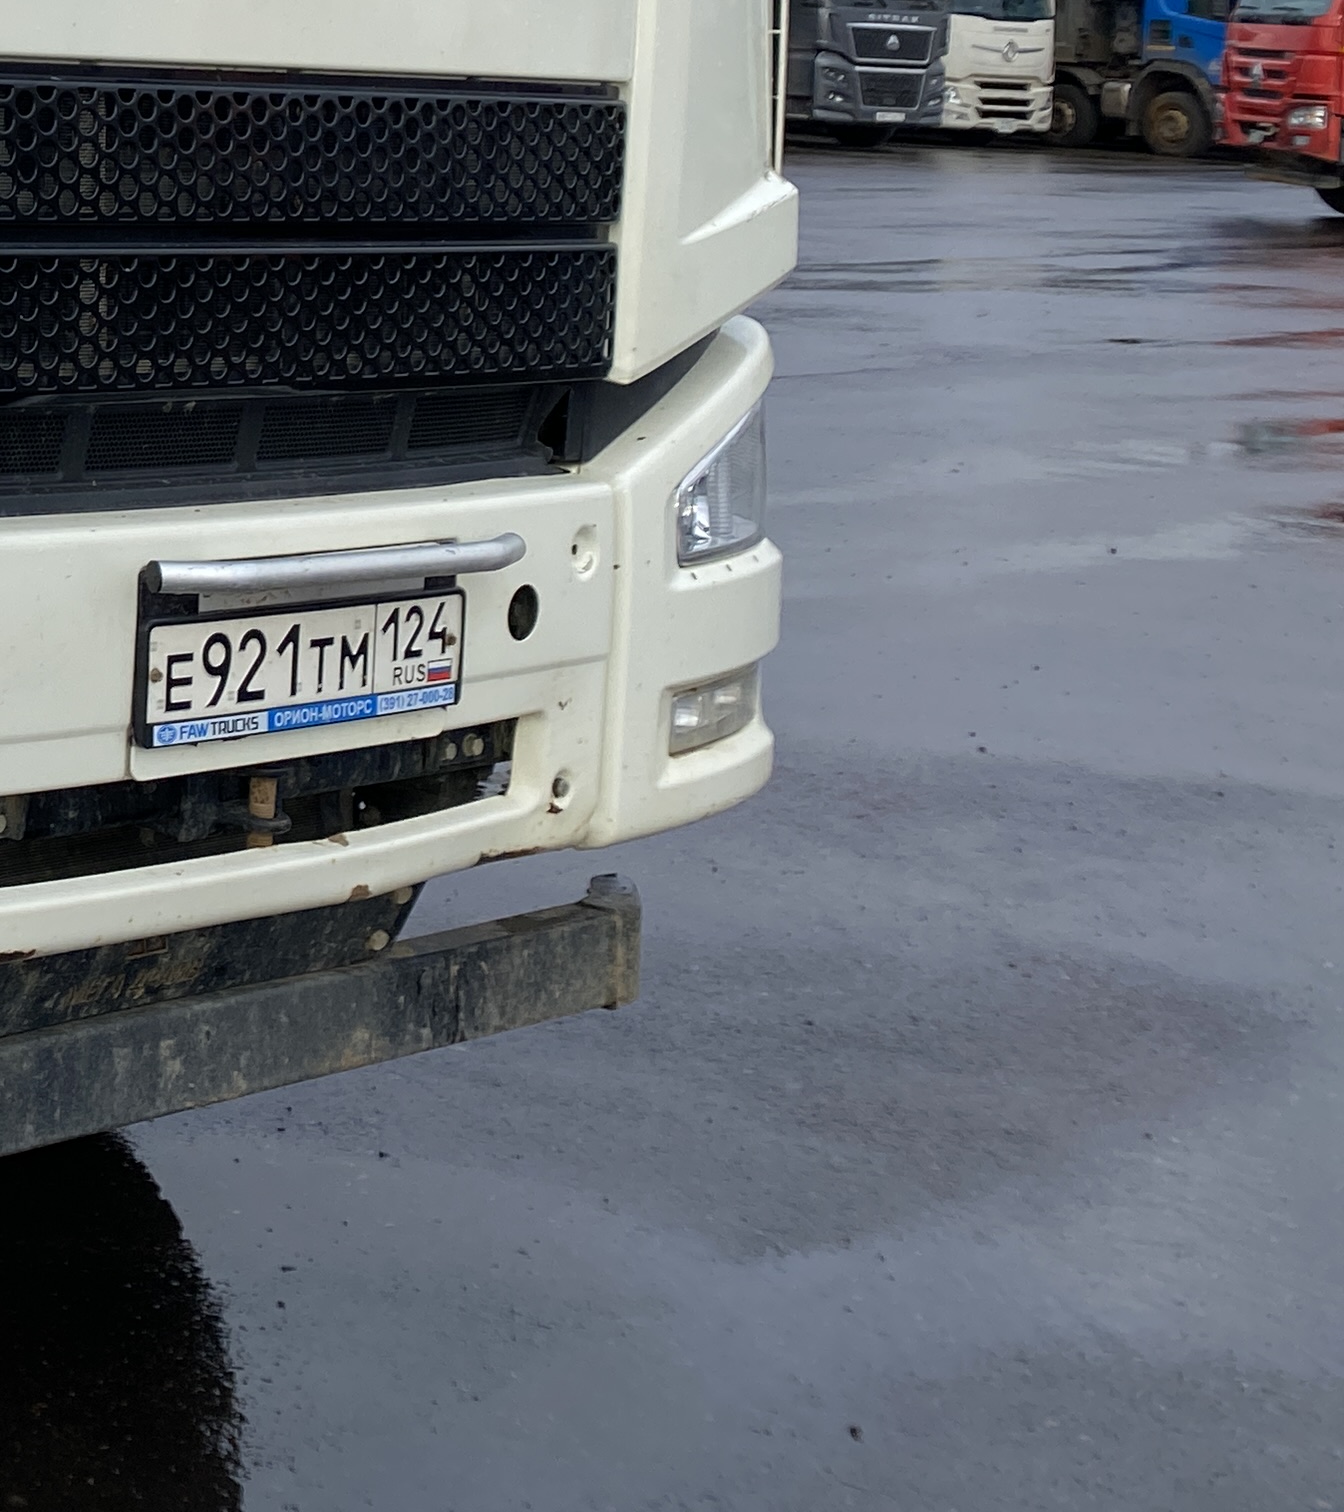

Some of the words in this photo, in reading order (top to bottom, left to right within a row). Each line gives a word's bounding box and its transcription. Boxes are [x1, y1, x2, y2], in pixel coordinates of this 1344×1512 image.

[164, 624, 370, 712] Е921ТМ
[382, 602, 448, 661] 124
[393, 663, 426, 686] RUS
[274, 699, 373, 727] ОРИОН-МОТОРС
[179, 723, 209, 740] FAW
[211, 716, 259, 735] TRUCKS
